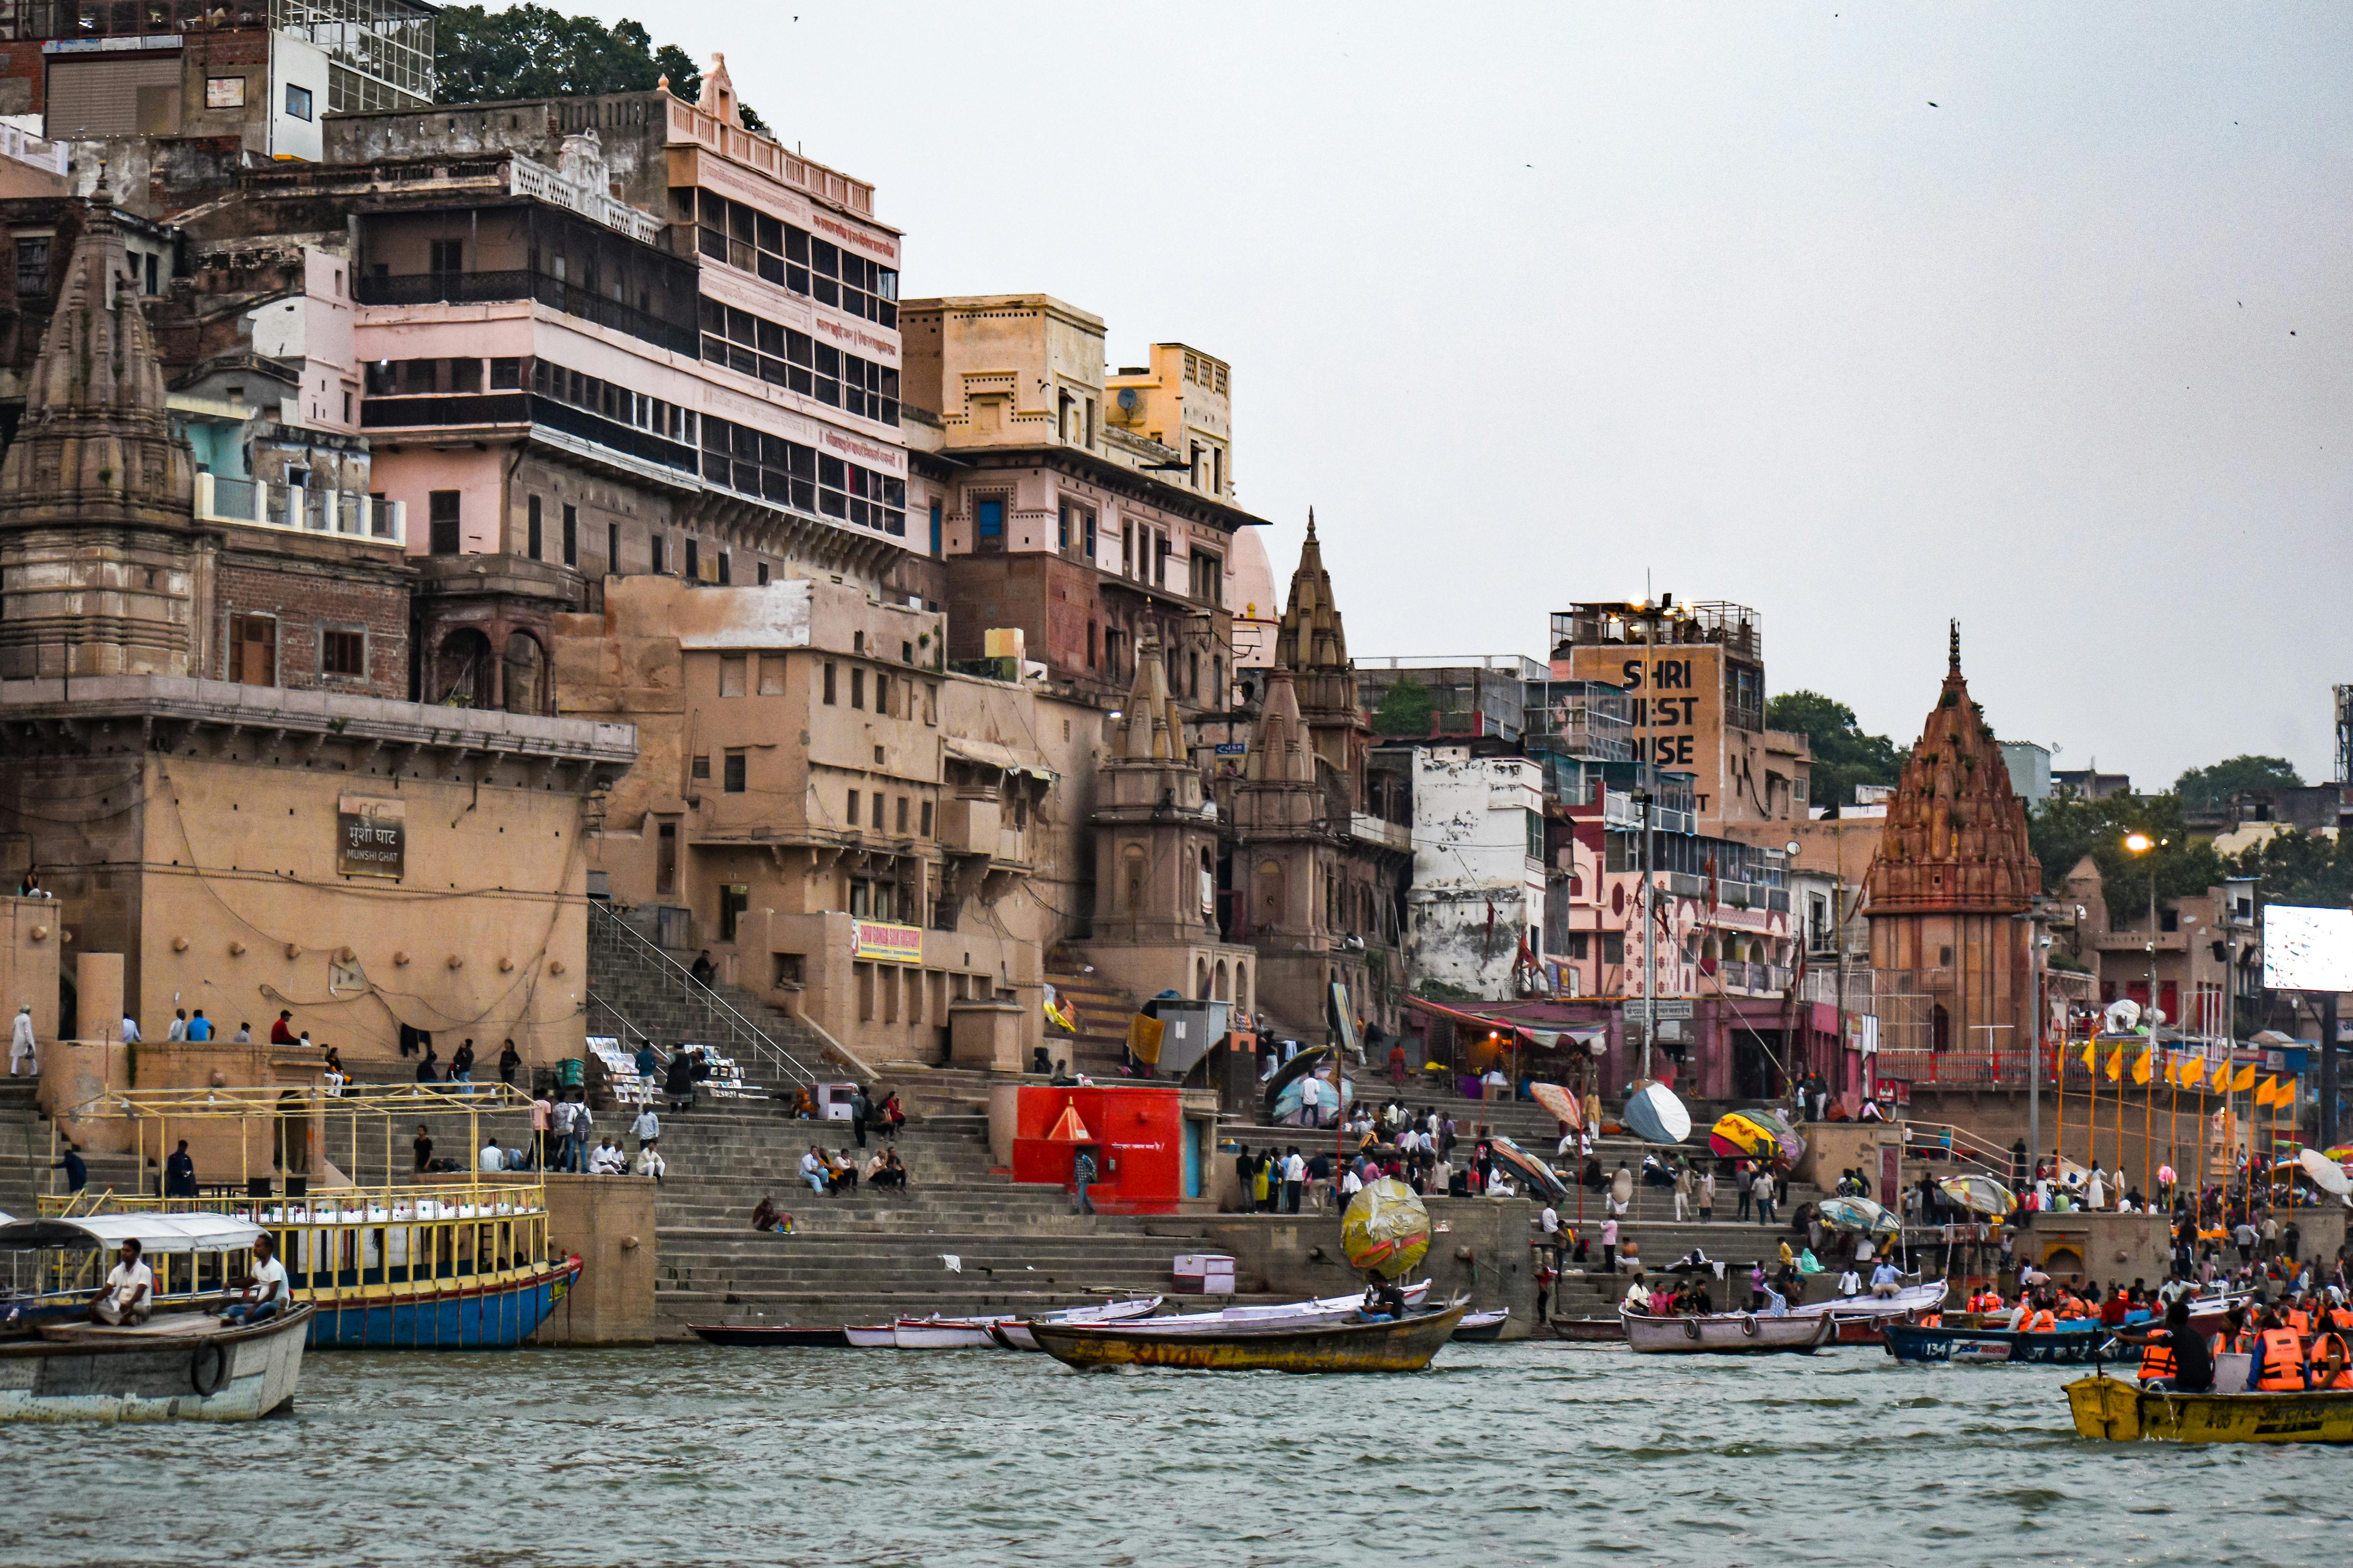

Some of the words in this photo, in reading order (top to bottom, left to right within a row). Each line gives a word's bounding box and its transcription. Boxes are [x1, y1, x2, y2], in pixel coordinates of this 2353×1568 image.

[1623, 660, 1691, 689] SHRI
[349, 823, 372, 847] मुंशी
[375, 828, 396, 845] घाट
[346, 848, 377, 861] MUNSHI
[379, 851, 398, 863] GHAT
[861, 925, 872, 943] SHIV
[873, 926, 889, 946] GANGA
[900, 929, 920, 948] FACTORY
